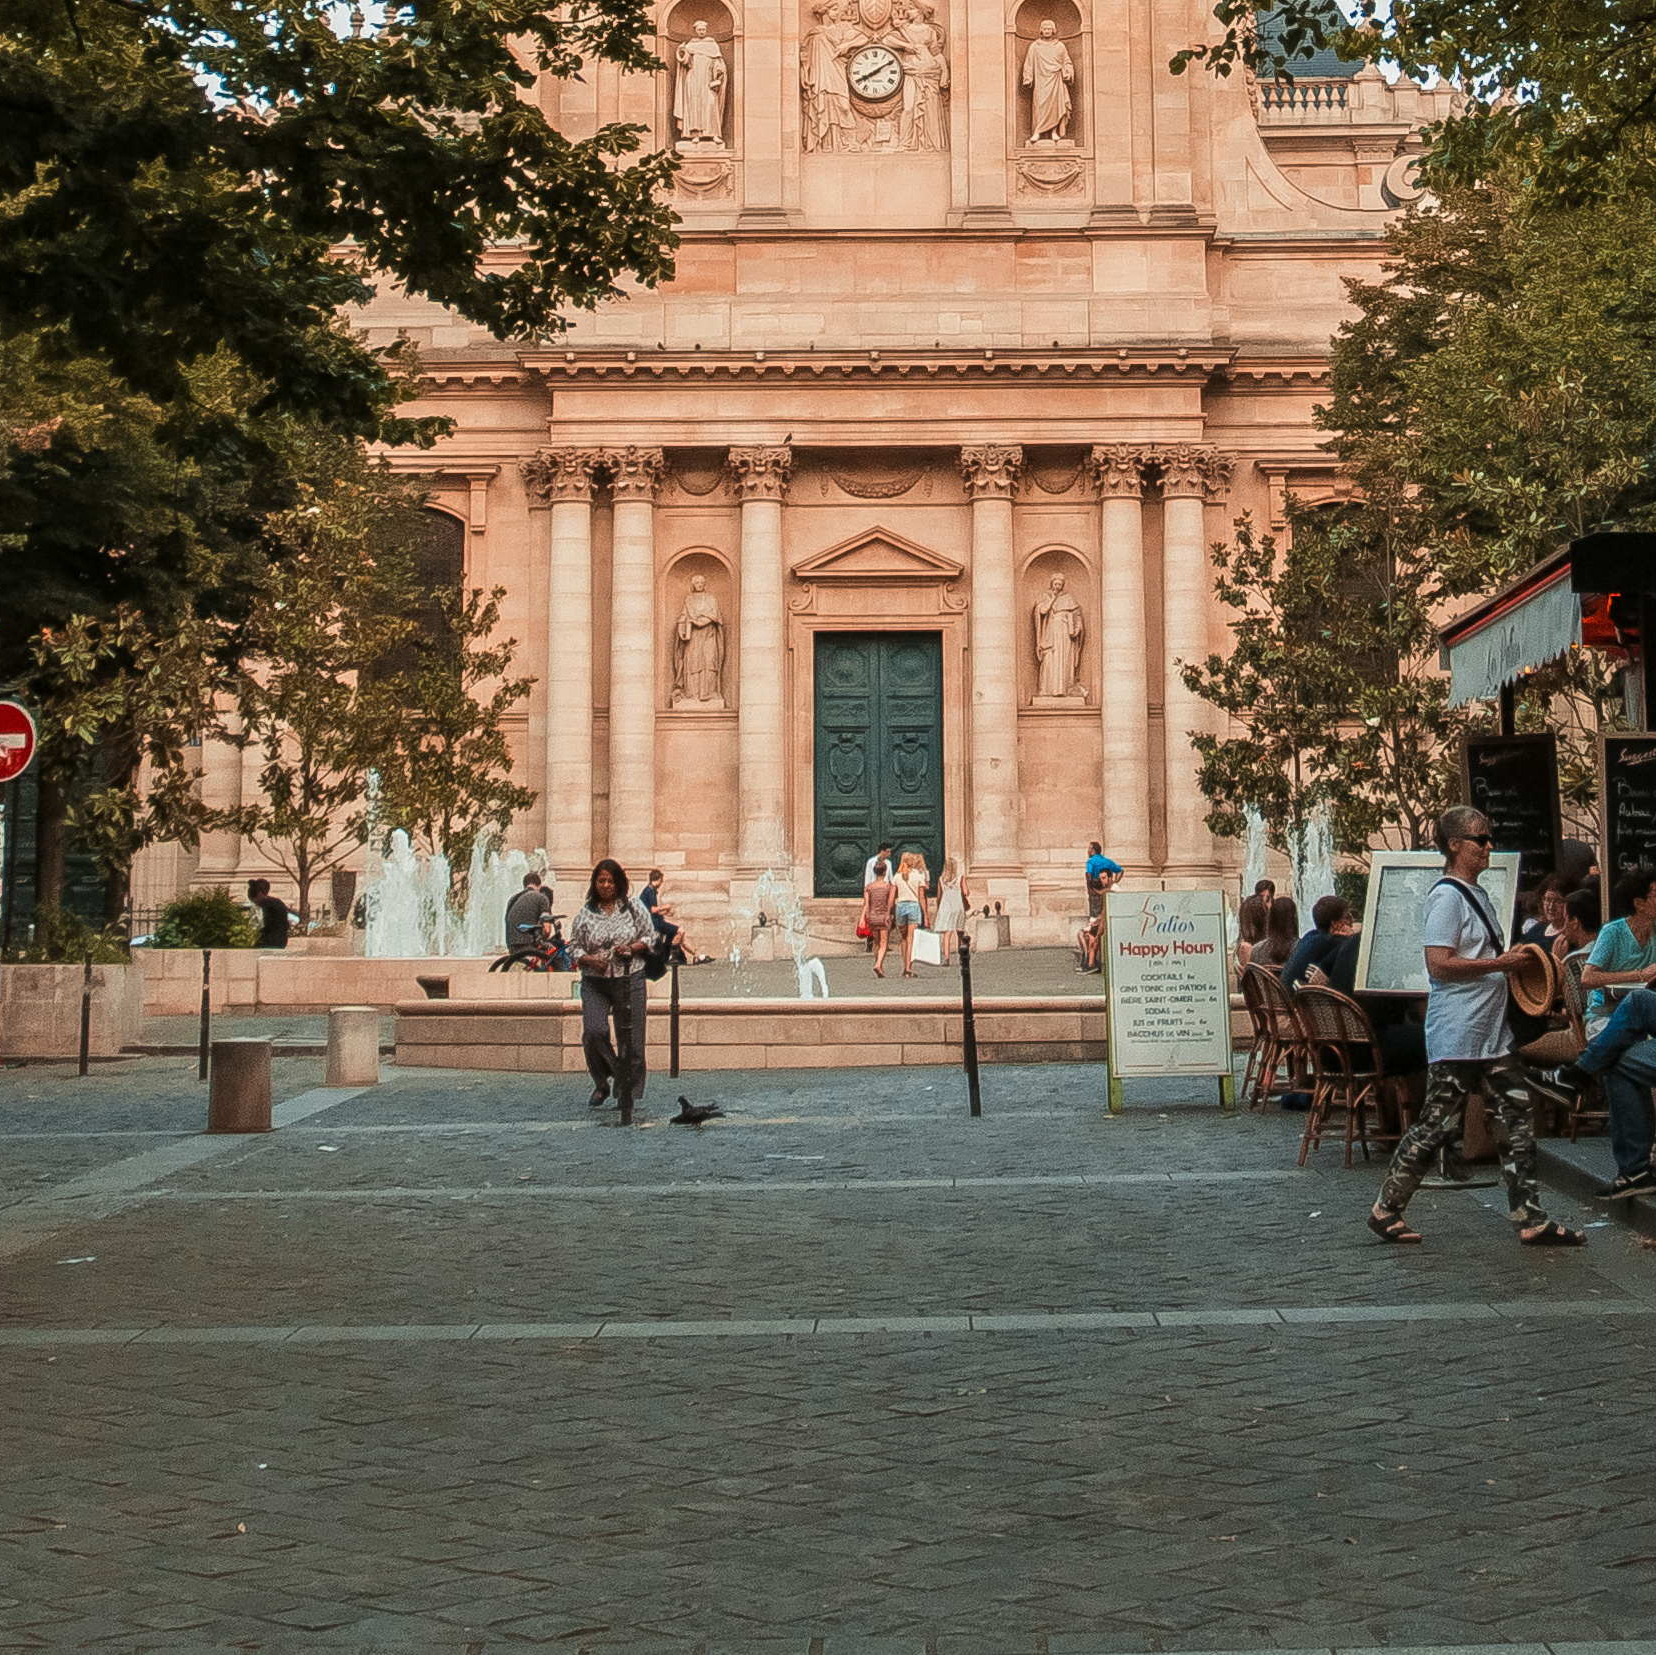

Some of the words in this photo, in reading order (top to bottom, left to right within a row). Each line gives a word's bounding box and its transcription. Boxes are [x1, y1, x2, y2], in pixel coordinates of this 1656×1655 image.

[1141, 910, 1195, 938] Patios
[1119, 941, 1170, 959] Happy
[1172, 940, 1215, 955] Hours
[1141, 973, 1183, 982] COCKTAILS
[1141, 985, 1165, 993] TONIC
[1179, 984, 1207, 992] PATIOS
[1144, 1007, 1170, 1015] SODAS
[1157, 1018, 1183, 1026] FRUITS
[1176, 1029, 1190, 1037] VIN
